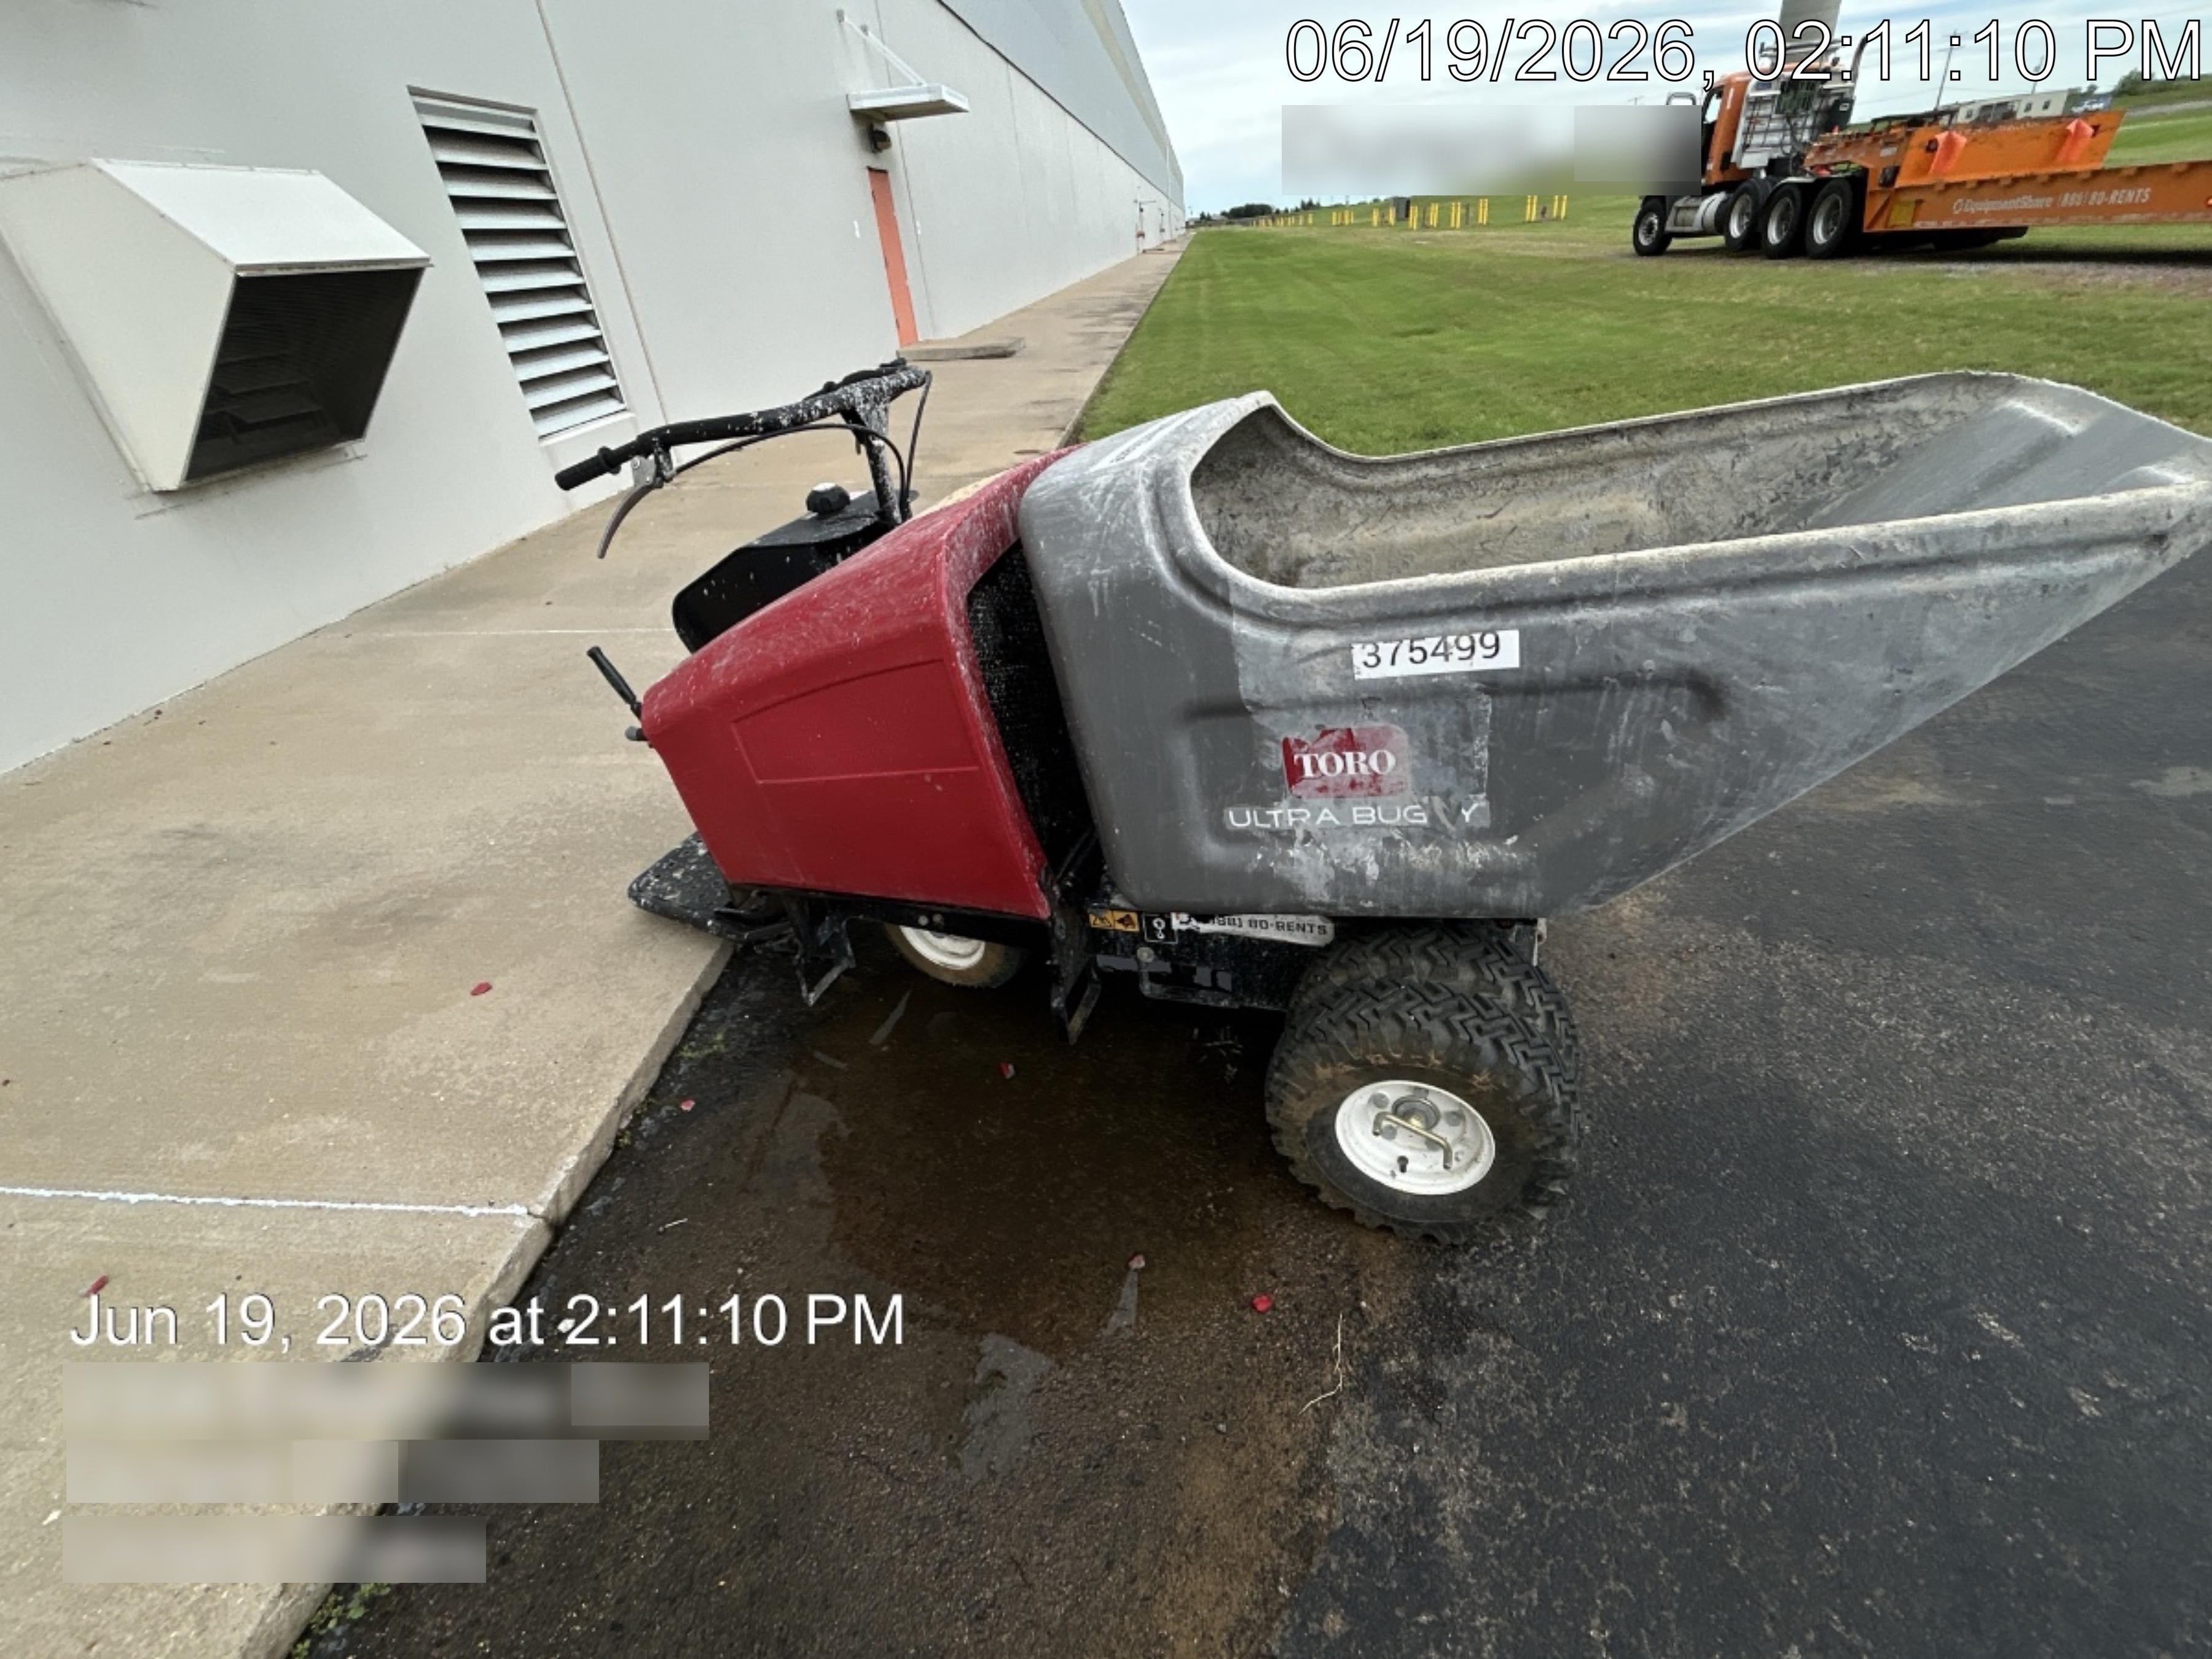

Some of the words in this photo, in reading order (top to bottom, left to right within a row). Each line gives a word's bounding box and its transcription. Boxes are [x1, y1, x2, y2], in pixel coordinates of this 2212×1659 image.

[1362, 630, 1500, 669] 375499
[1294, 750, 1396, 778] TORO
[1228, 807, 1341, 828] ULTRA
[1352, 804, 1484, 825] BUGY
